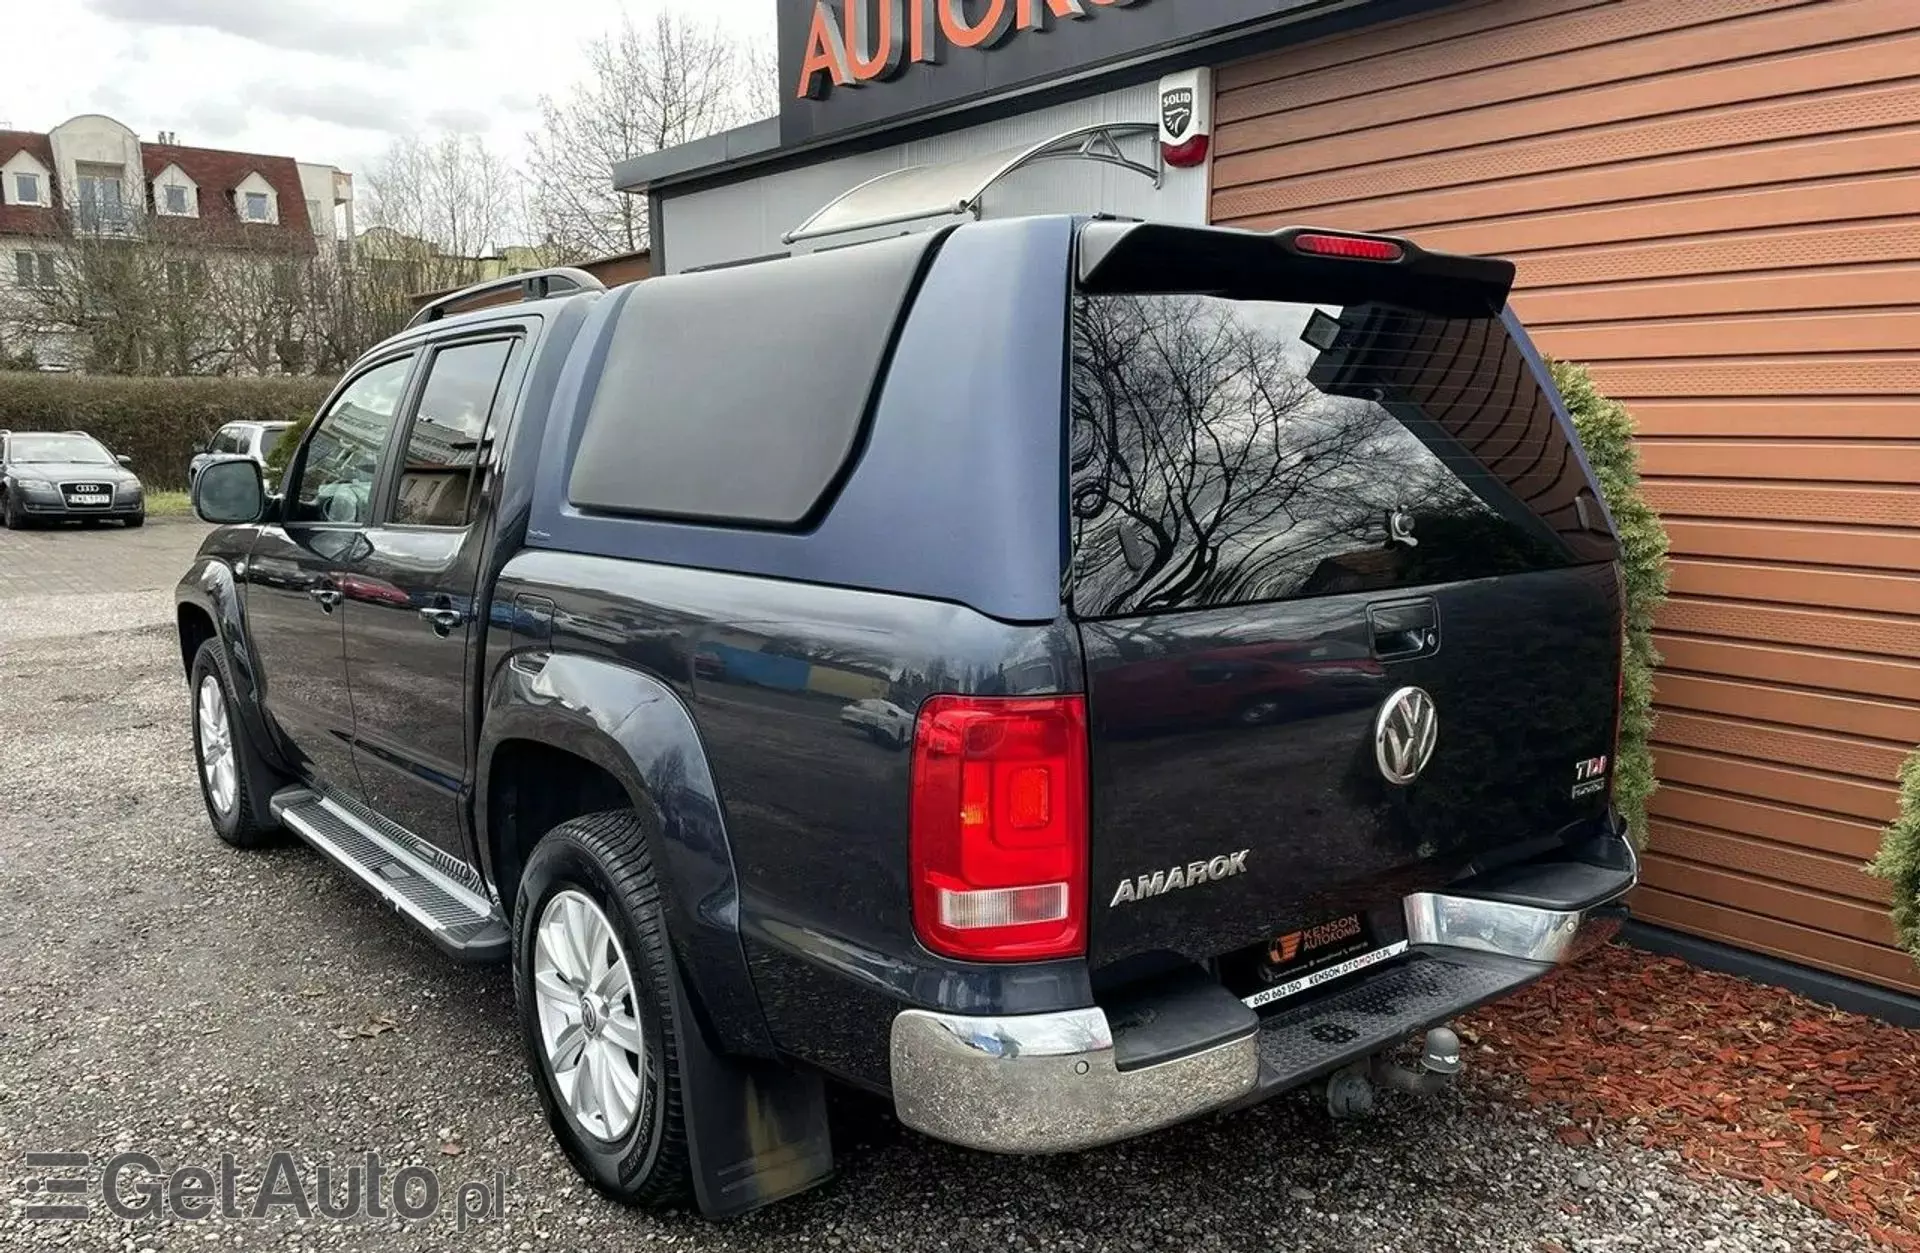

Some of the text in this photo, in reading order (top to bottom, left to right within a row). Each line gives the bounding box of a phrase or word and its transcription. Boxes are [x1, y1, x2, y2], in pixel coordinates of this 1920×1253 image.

[1163, 92, 1191, 107] SOLID
[1110, 849, 1250, 907] AMAROK
[1303, 914, 1359, 940] KENSON
[1303, 924, 1362, 951] AUTOKOMIS
